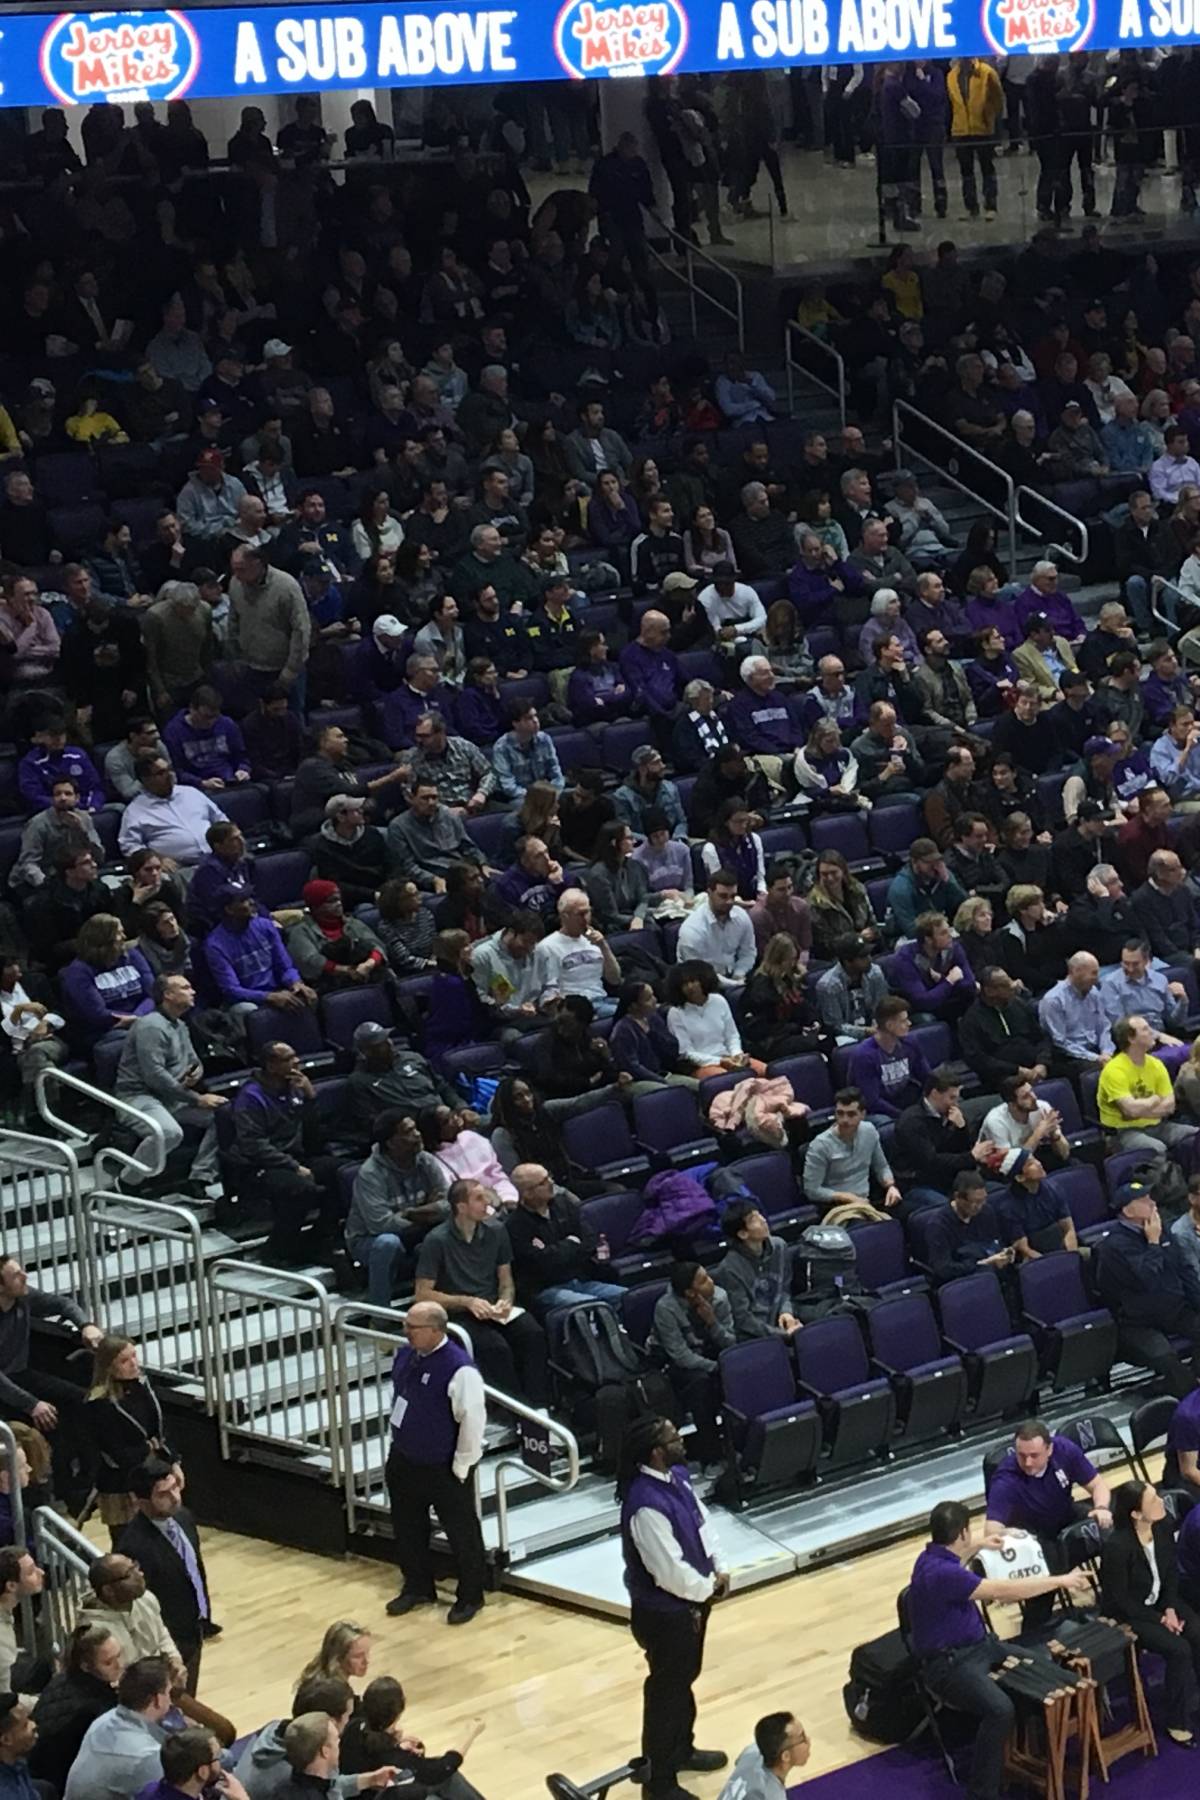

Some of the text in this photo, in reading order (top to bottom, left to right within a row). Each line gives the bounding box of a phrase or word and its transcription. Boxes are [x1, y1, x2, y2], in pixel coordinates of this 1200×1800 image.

[574, 4, 668, 34] Jersey
[717, 0, 956, 60] A SUB ABOVE
[1119, 0, 1143, 38] A
[64, 22, 176, 57] Jersey
[234, 11, 517, 84] A SUB ABOVE
[523, 1436, 548, 1454] 106
